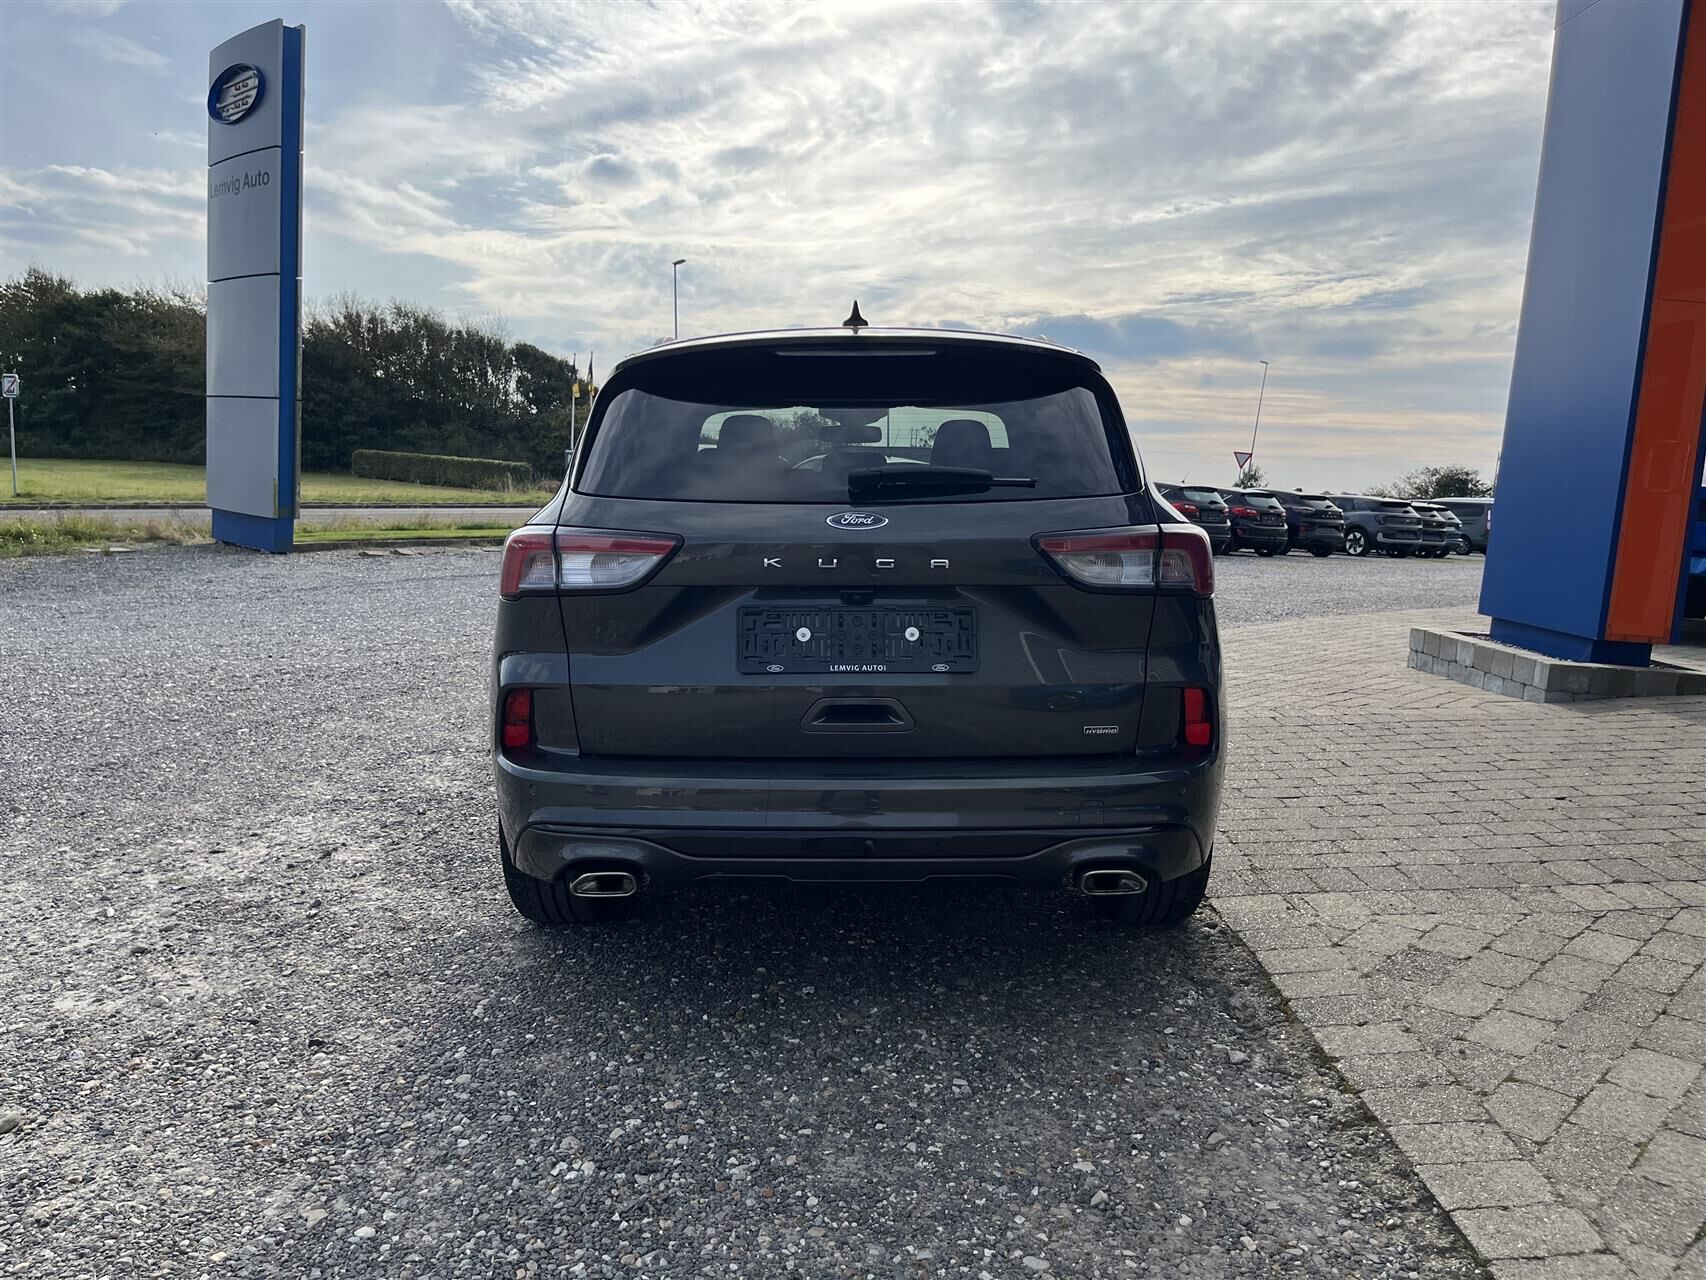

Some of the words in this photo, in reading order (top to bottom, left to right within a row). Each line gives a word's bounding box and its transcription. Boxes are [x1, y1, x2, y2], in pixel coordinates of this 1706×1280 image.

[210, 176, 240, 199] Lemvig
[242, 169, 270, 189] Auto
[841, 513, 874, 524] Ford
[763, 558, 950, 569] KUGA
[830, 664, 860, 672] LEMVIG
